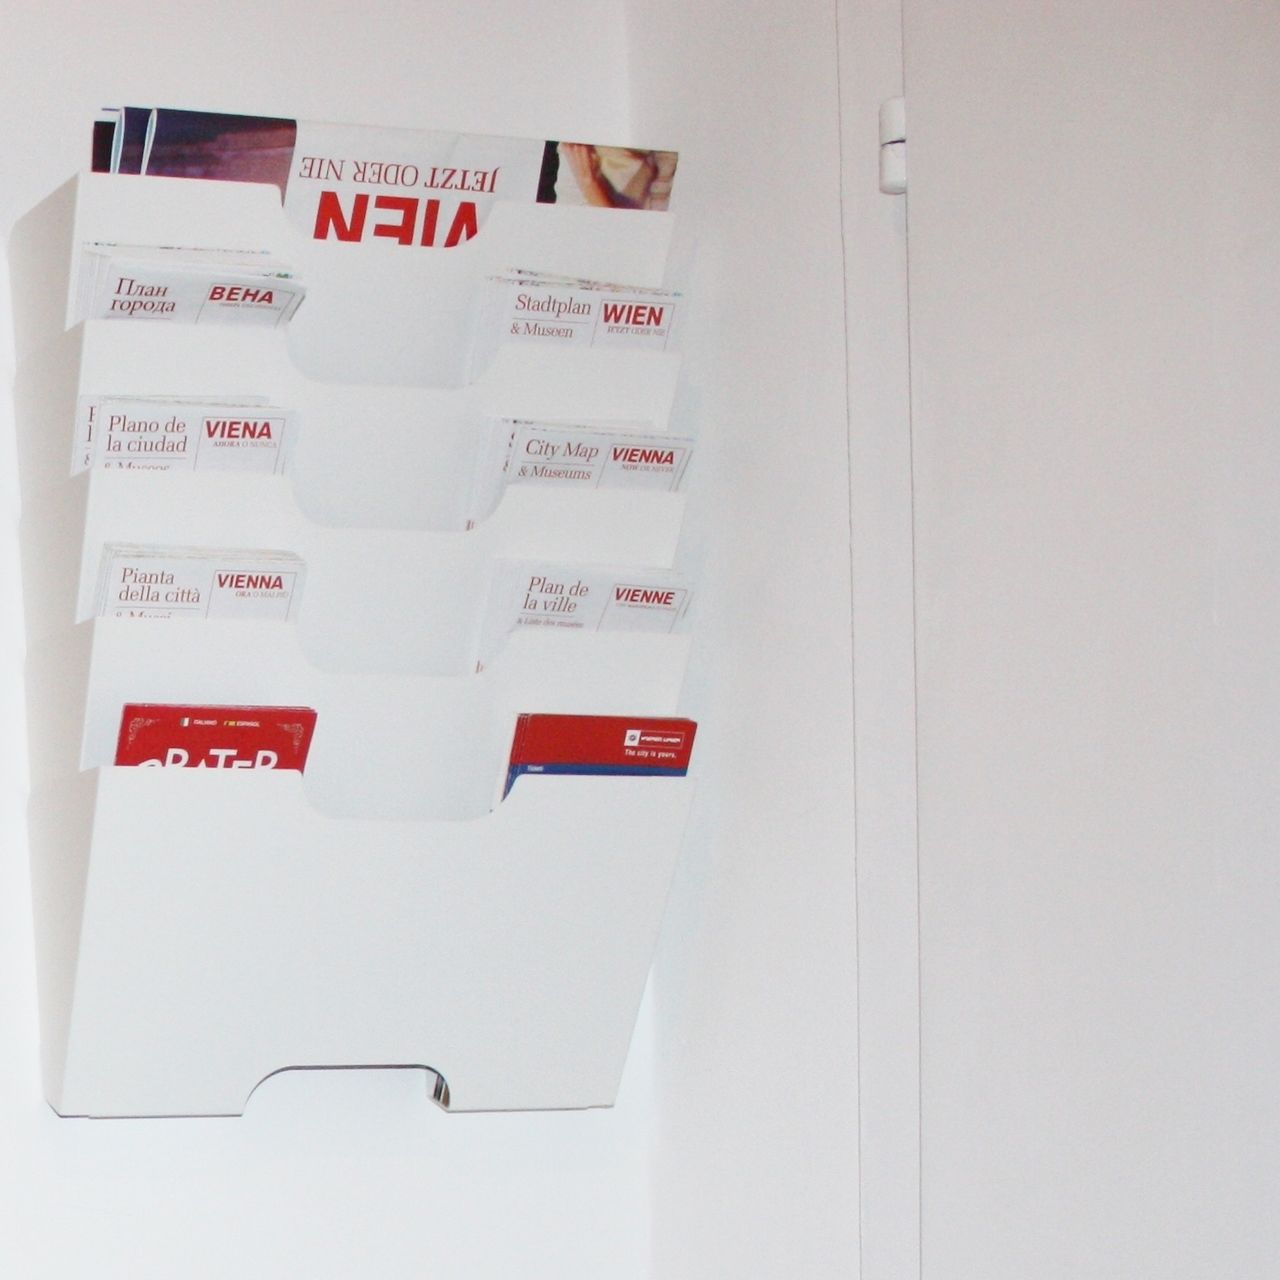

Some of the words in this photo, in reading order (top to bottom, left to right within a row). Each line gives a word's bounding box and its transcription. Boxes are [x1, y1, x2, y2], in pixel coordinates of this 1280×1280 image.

[299, 156, 346, 181] NIE
[353, 160, 420, 187] ODER
[424, 166, 501, 193] JETZT
[114, 277, 169, 297] План
[208, 285, 274, 304] ВЕНА
[110, 298, 176, 316] города
[515, 293, 592, 318] Stadtplan
[603, 303, 664, 326] WIEN
[510, 322, 520, 335] &
[523, 322, 573, 338] Museen
[108, 415, 159, 433] Plano
[164, 415, 186, 433] de
[205, 420, 272, 439] VIENA
[106, 435, 123, 452] la
[127, 435, 188, 453] ciudad
[526, 438, 560, 461] City
[563, 442, 599, 469] Map
[612, 447, 674, 465] VIENNA
[518, 467, 529, 477] &
[531, 466, 592, 481] Museums
[121, 567, 175, 585] Pianta
[217, 573, 284, 590] VIENNA
[118, 585, 160, 602] della
[164, 587, 201, 604] città
[528, 576, 563, 595] Plan
[569, 580, 589, 597] de
[615, 587, 675, 605] VIENNE
[523, 594, 537, 610] la
[543, 595, 577, 613] ville
